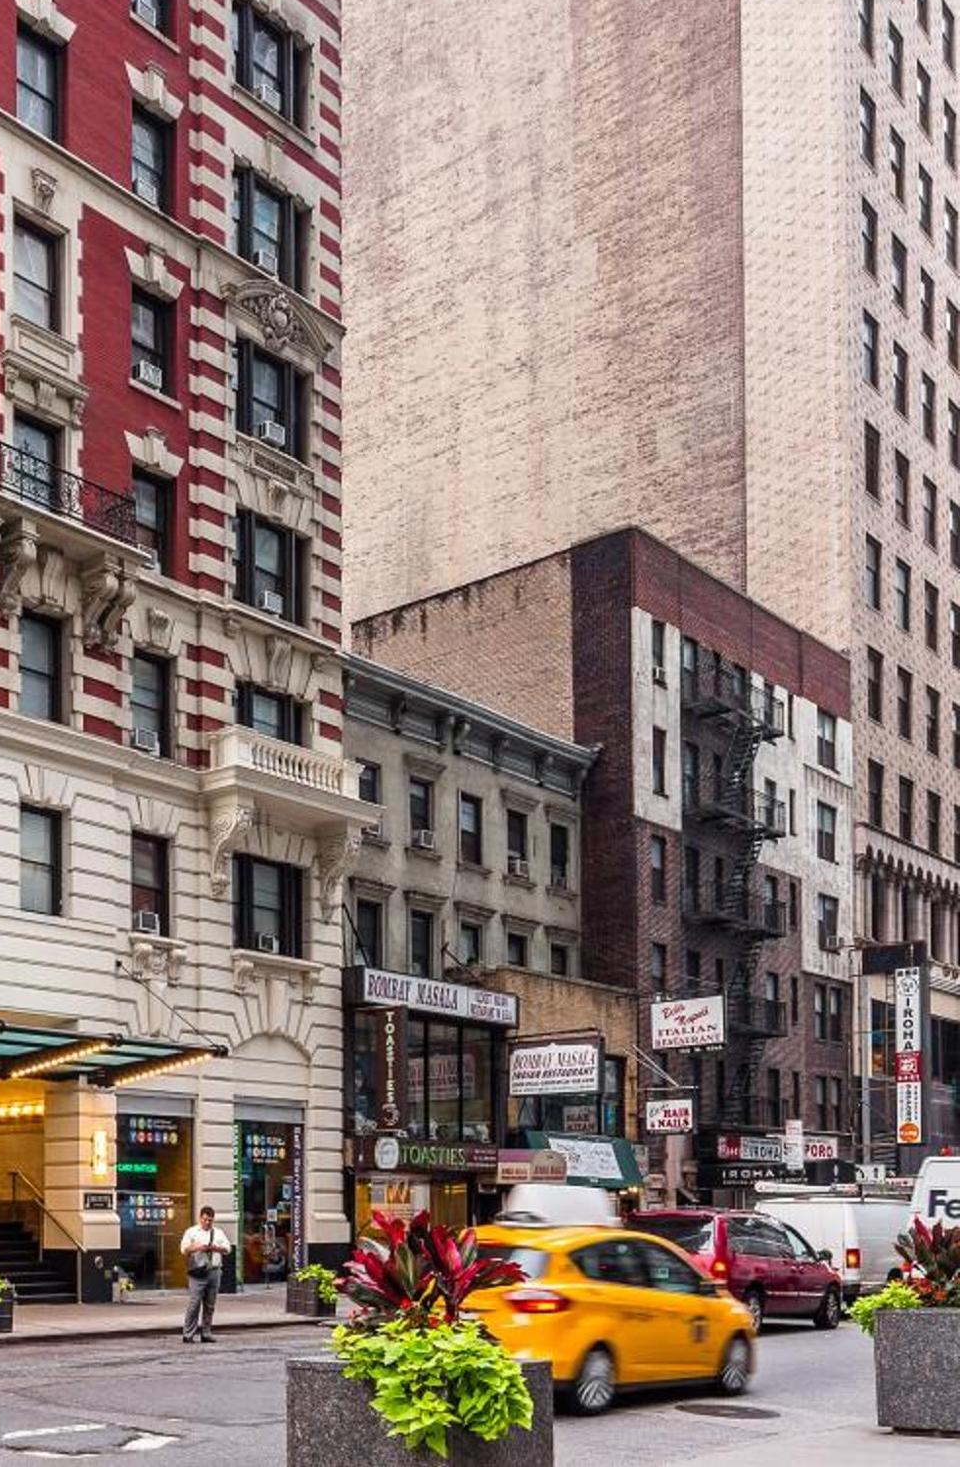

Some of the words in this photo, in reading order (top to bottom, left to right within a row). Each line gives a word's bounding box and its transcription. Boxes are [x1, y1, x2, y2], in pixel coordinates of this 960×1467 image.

[368, 974, 411, 1002] BOMBAY
[416, 983, 459, 1010] MASALA
[658, 1025, 717, 1036] ITALIAN
[902, 997, 915, 1051] IROHA
[384, 1011, 396, 1103] TOASTIES
[658, 1118, 690, 1129] NAILS
[401, 1145, 466, 1166] TOASTIES
[722, 1169, 775, 1179] IROHA
[926, 1189, 960, 1220] Fe
